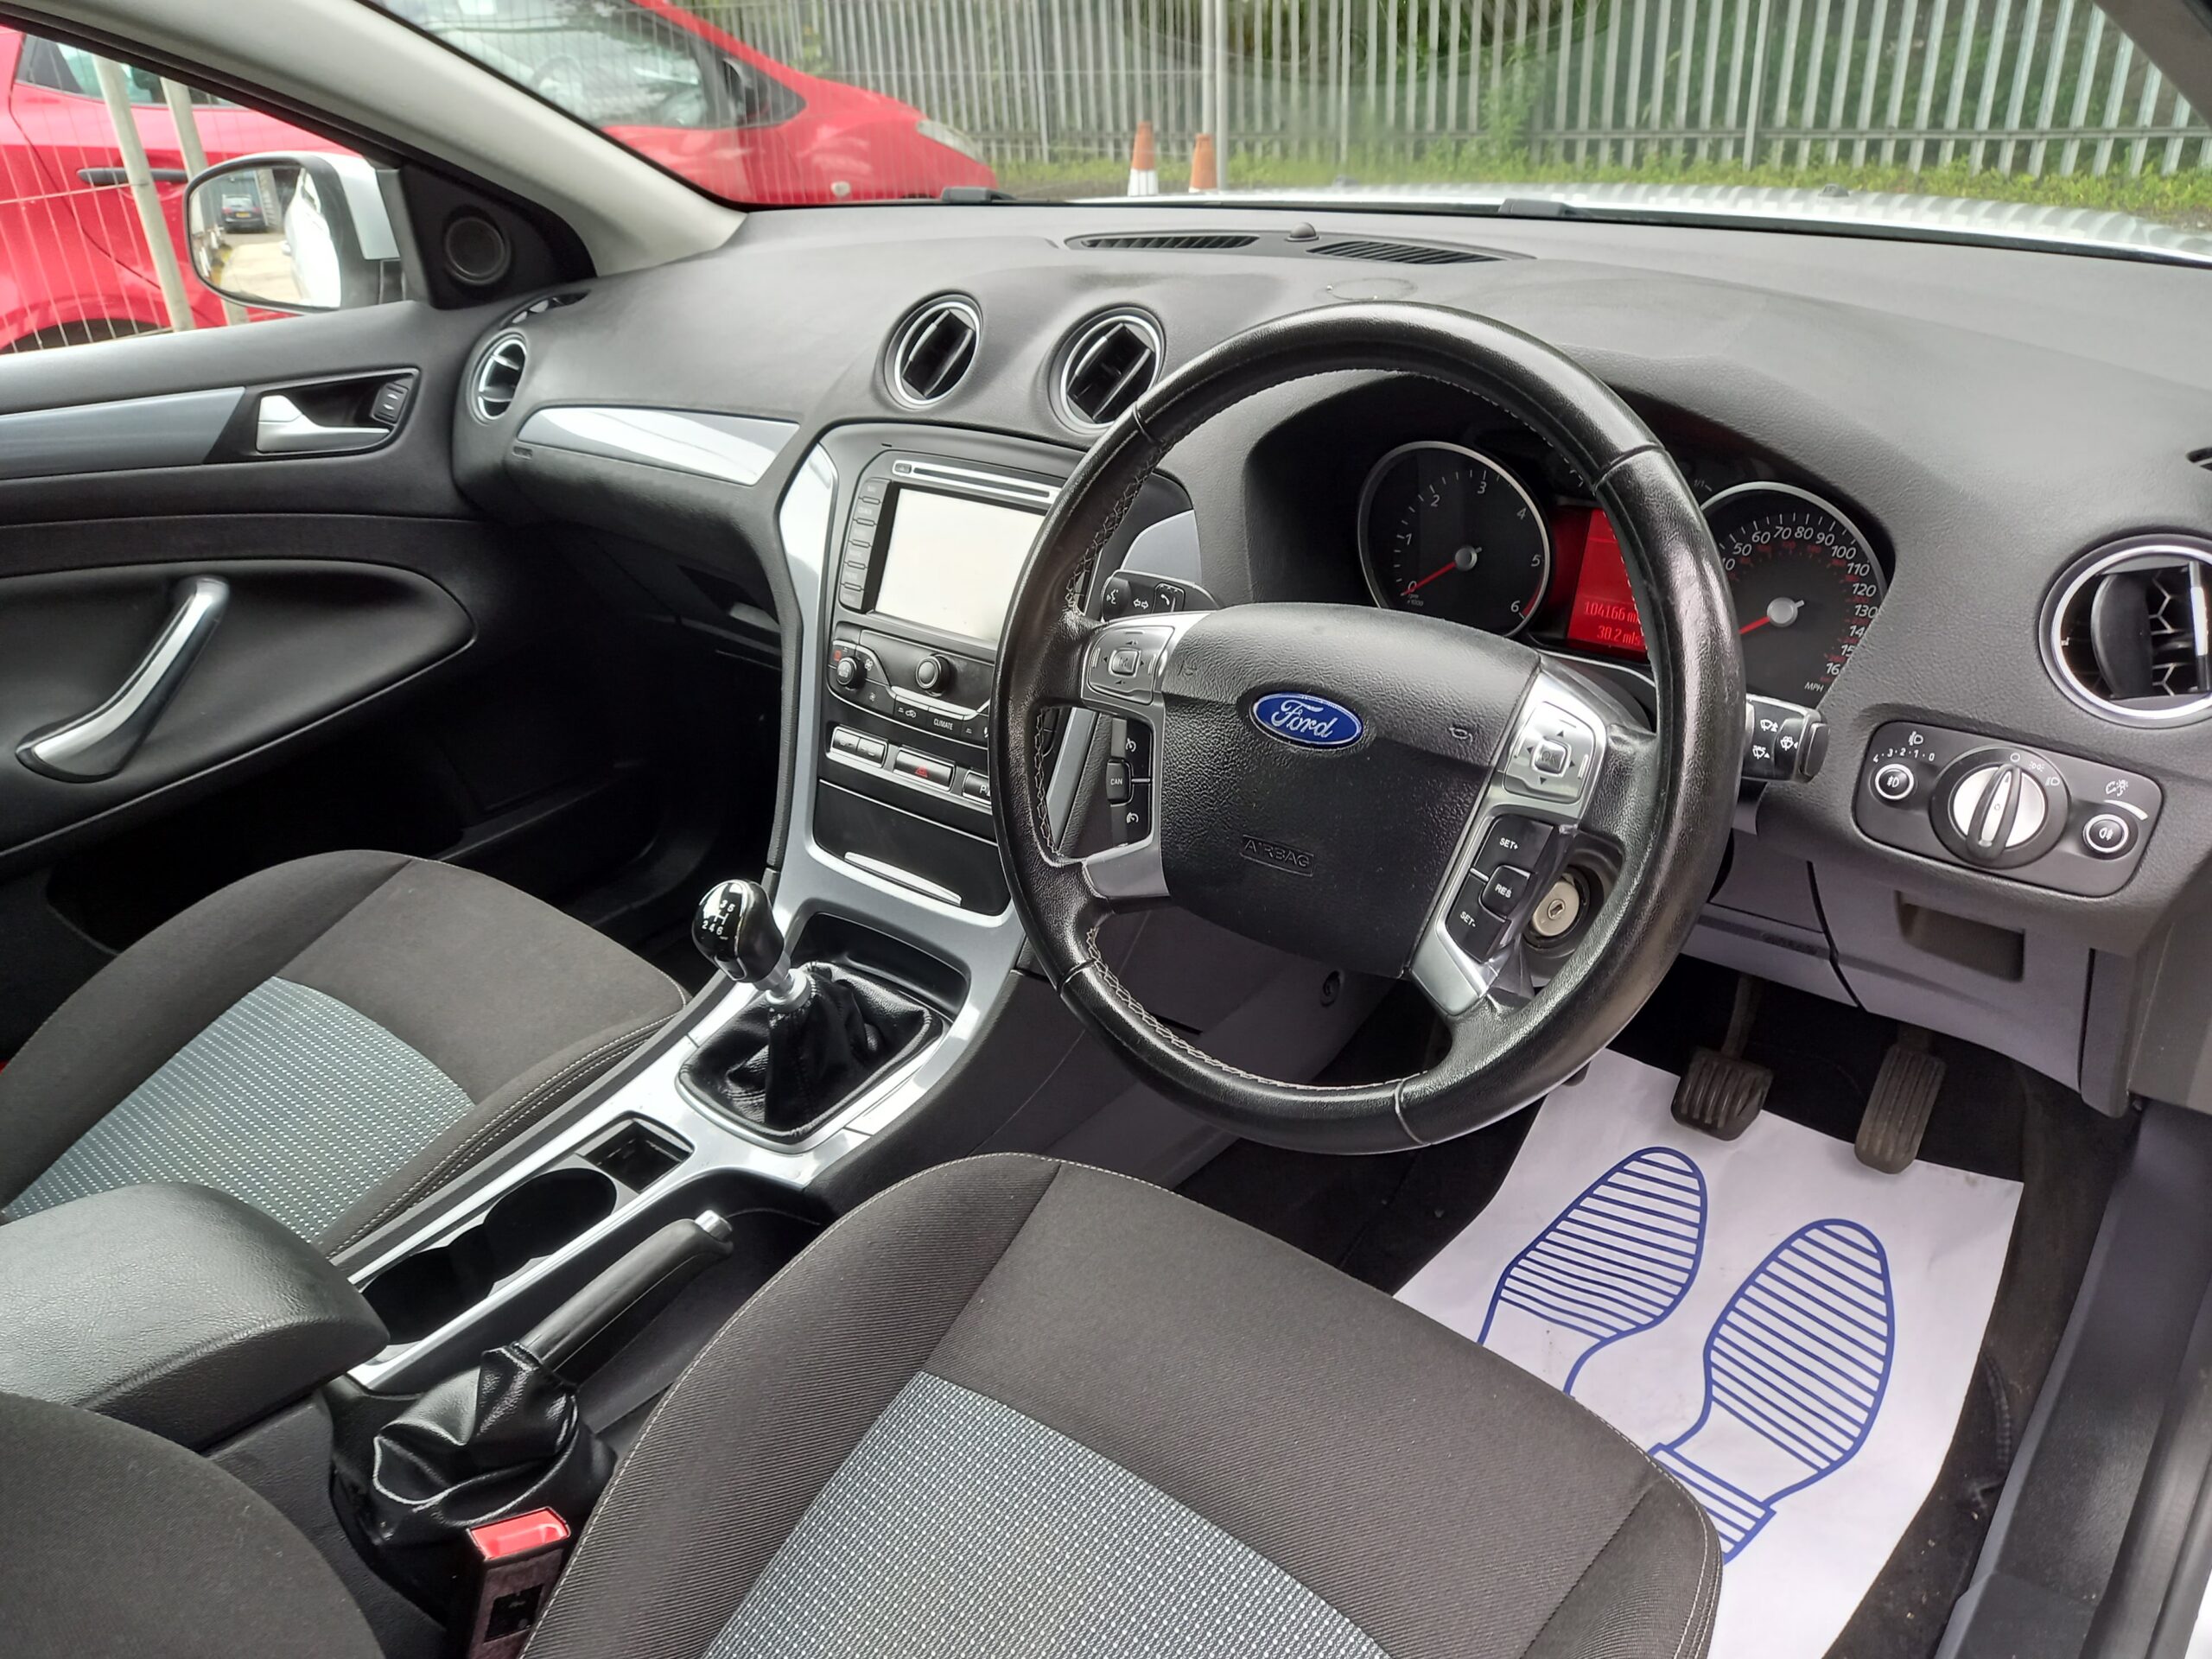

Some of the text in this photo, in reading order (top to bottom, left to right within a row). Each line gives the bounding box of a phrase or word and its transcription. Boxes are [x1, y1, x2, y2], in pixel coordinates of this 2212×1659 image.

[1477, 481, 1487, 494] 3
[1431, 494, 1440, 507] 2
[1516, 508, 1527, 520] 4
[1406, 533, 1413, 545] 1
[1751, 531, 1770, 544] 60
[1773, 526, 1792, 540] 70
[1794, 526, 1814, 540] 80
[1816, 532, 1834, 546] 90
[1732, 542, 1752, 556] 50
[1831, 545, 1857, 560] 100
[1531, 554, 1541, 567] 5
[1721, 557, 1736, 571] 0
[1847, 563, 1870, 576] 110
[1853, 582, 1877, 597] 120
[1510, 601, 1520, 612] 6
[1584, 601, 1625, 621] 104166
[1854, 604, 1878, 619] 130
[1849, 625, 1866, 638] 14
[1841, 644, 1854, 658] 15
[1826, 662, 1840, 676] 16
[1804, 681, 1824, 692] MPH
[933, 718, 954, 731] CLIMATE
[1270, 699, 1338, 738] Ford
[1873, 747, 1936, 763] 4 3 2 1 0
[1499, 837, 1518, 850] SET+
[1243, 839, 1310, 868] AIRBAG
[1495, 883, 1512, 899] RES
[720, 899, 728, 908] 3
[702, 919, 723, 936] 2 4 6
